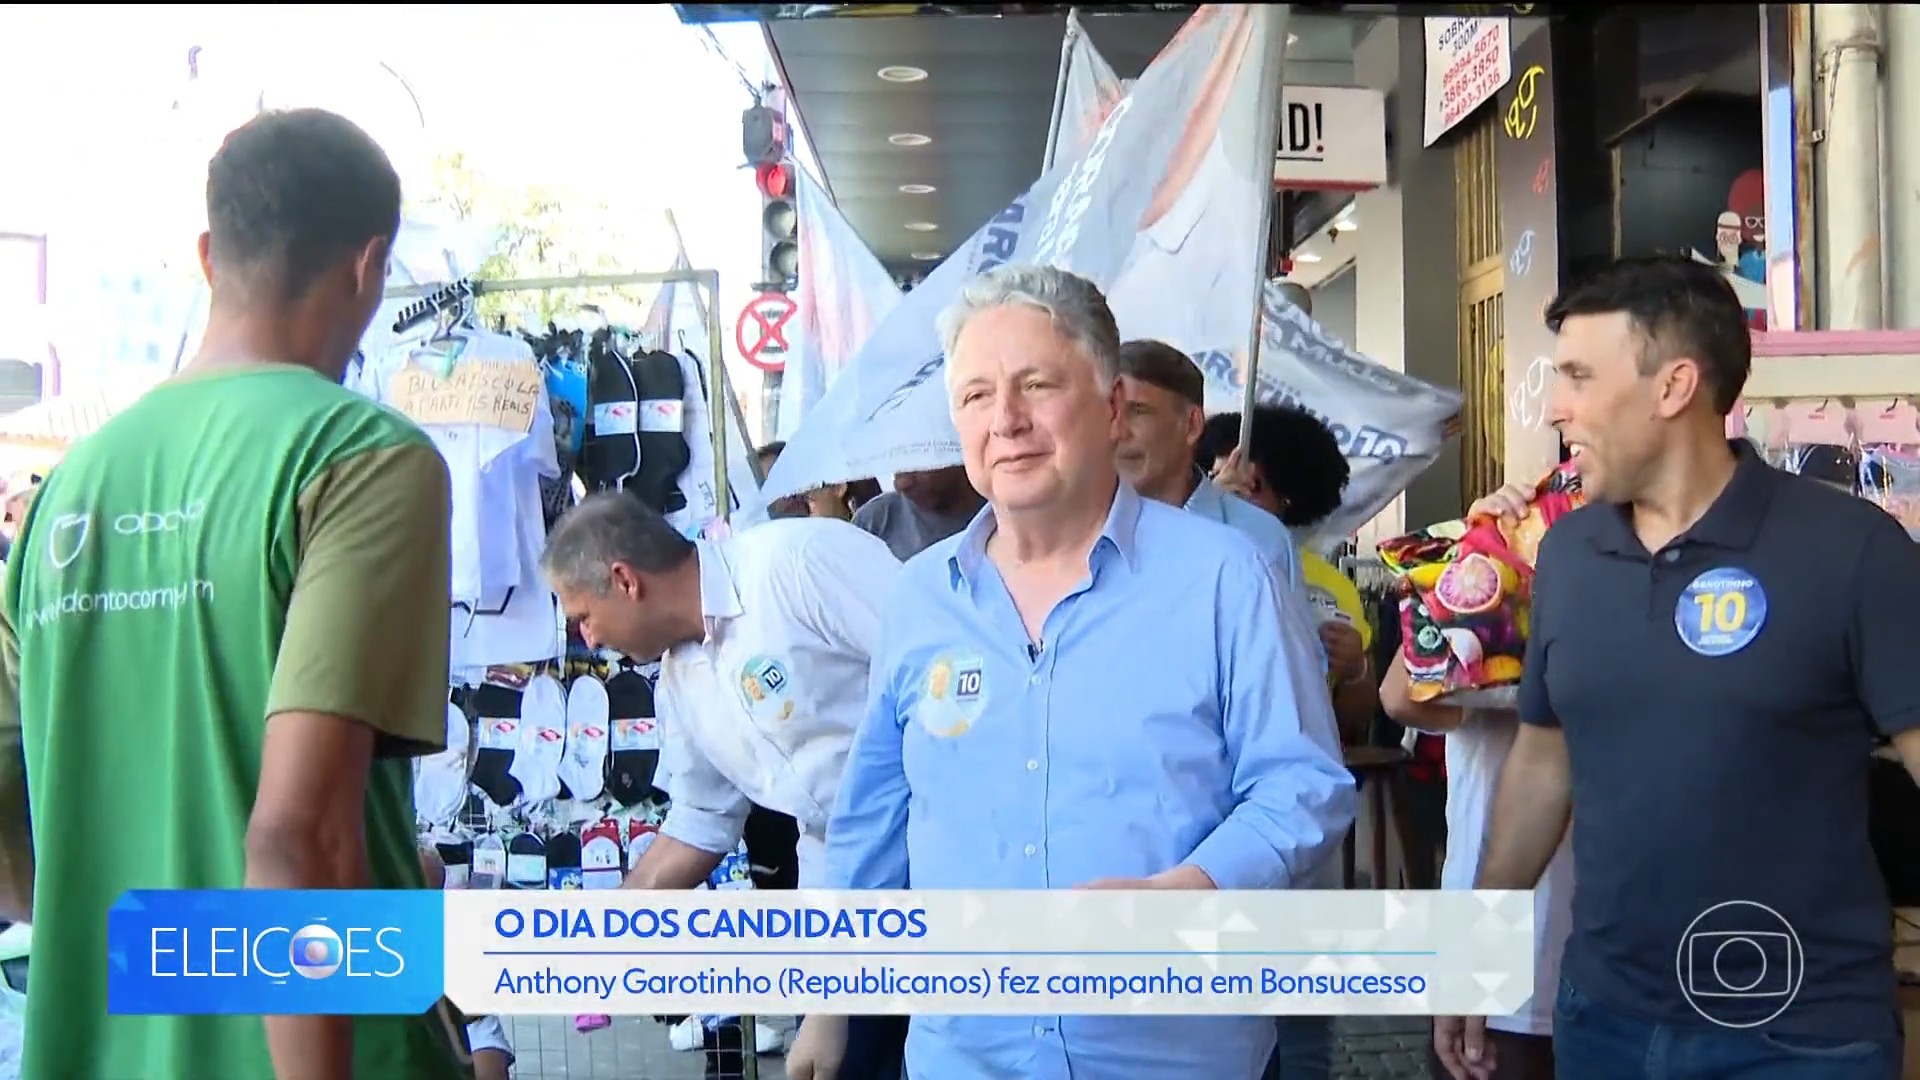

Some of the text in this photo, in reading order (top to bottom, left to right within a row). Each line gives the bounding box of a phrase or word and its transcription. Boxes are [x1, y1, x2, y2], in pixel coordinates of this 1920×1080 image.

[1277, 102, 1324, 153] D!
[1693, 591, 1746, 633] 10
[763, 668, 782, 687] 10
[959, 671, 981, 694] 10
